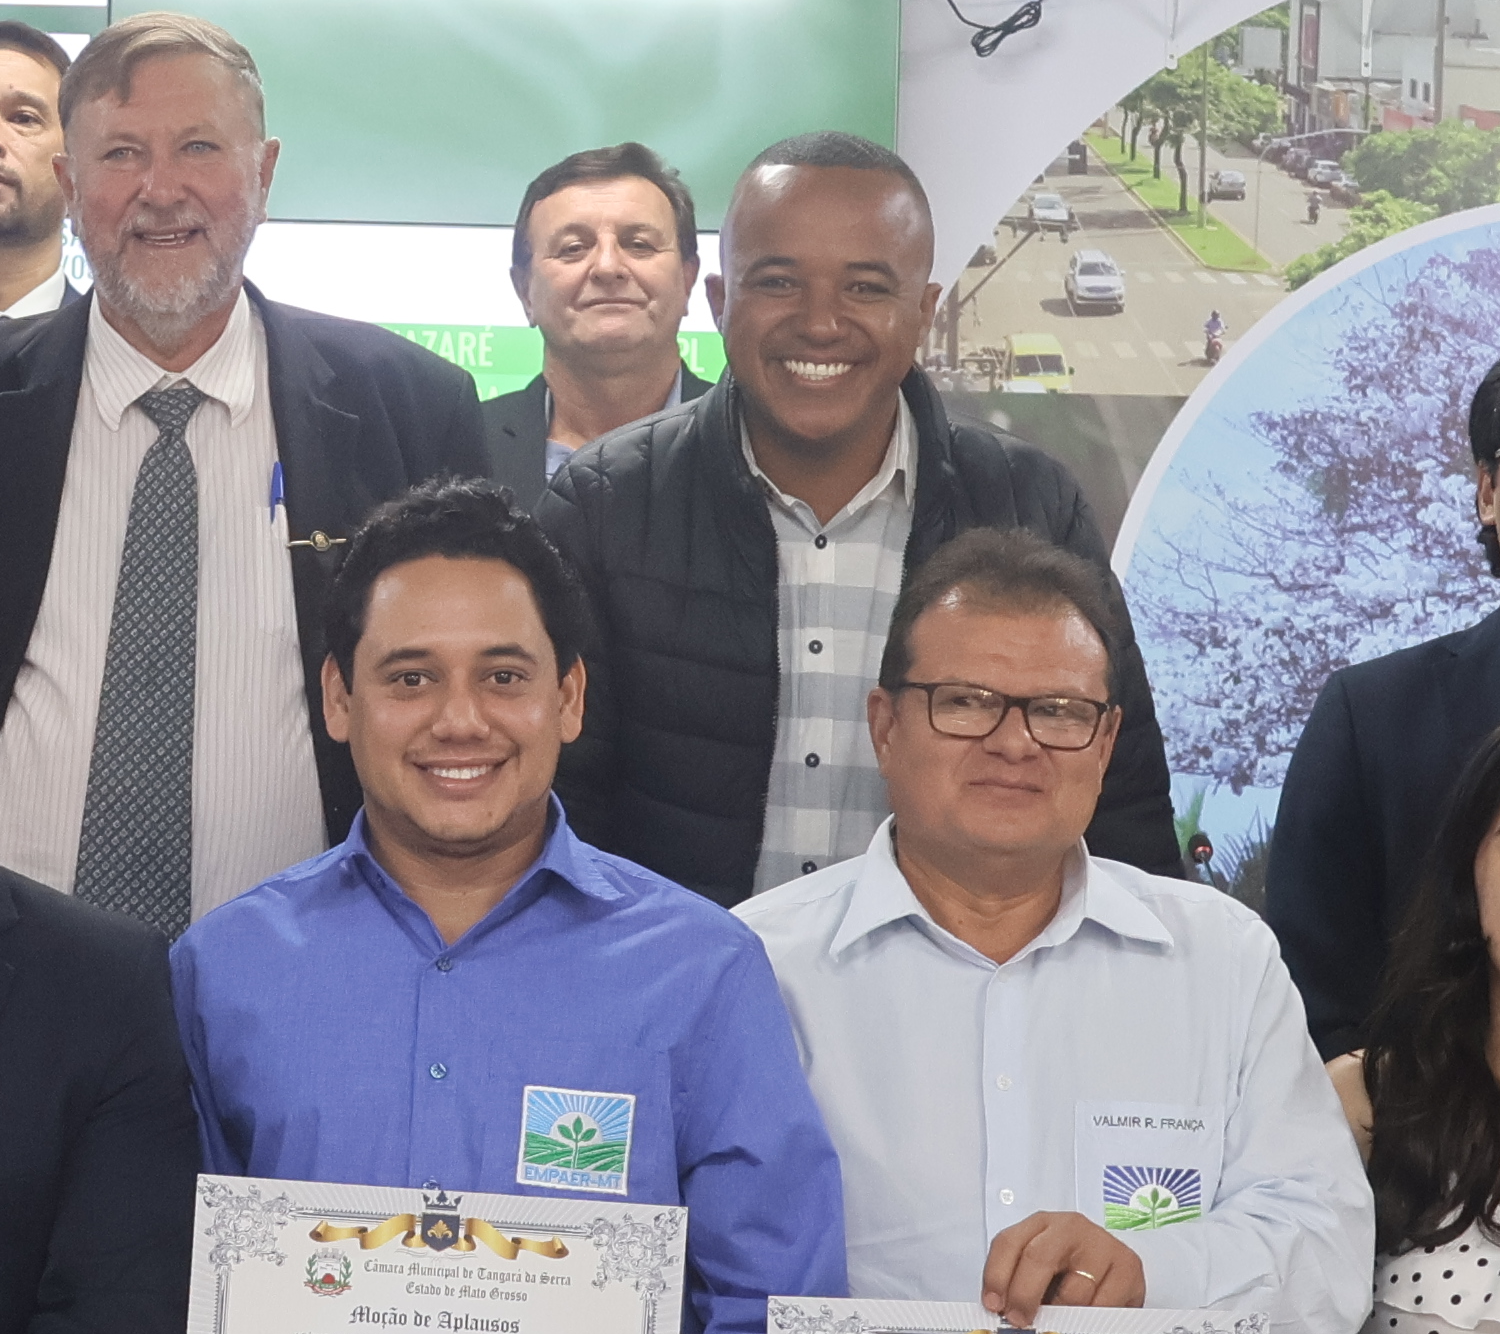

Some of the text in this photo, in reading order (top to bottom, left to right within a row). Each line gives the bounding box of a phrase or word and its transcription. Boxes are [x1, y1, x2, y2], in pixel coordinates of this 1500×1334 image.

[1093, 1115, 1141, 1127] VALMIR
[1161, 1118, 1205, 1132] FRANÇA
[524, 1165, 623, 1189] EMPAER-MT
[349, 1305, 519, 1334] Moção de Aplausos
